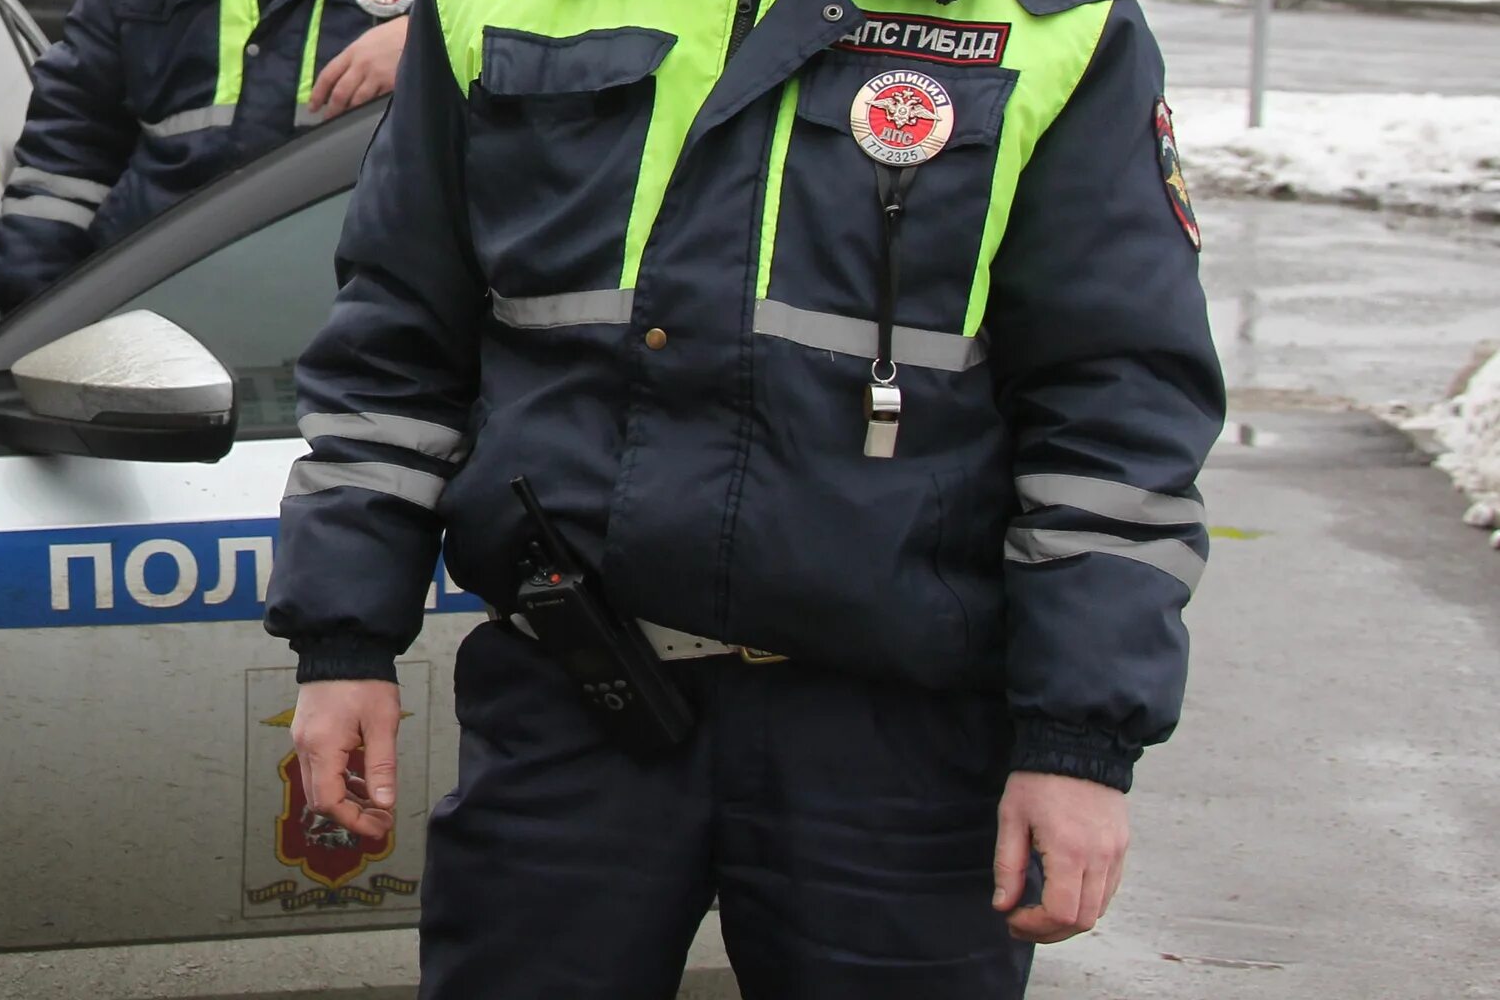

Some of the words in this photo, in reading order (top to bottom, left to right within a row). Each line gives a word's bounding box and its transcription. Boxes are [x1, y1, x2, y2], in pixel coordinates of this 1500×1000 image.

[902, 24, 999, 59] ГИБДД
[870, 72, 948, 105] ПОЛИЦИЯ
[879, 126, 915, 145] ДПС
[865, 140, 919, 163] 77-2325
